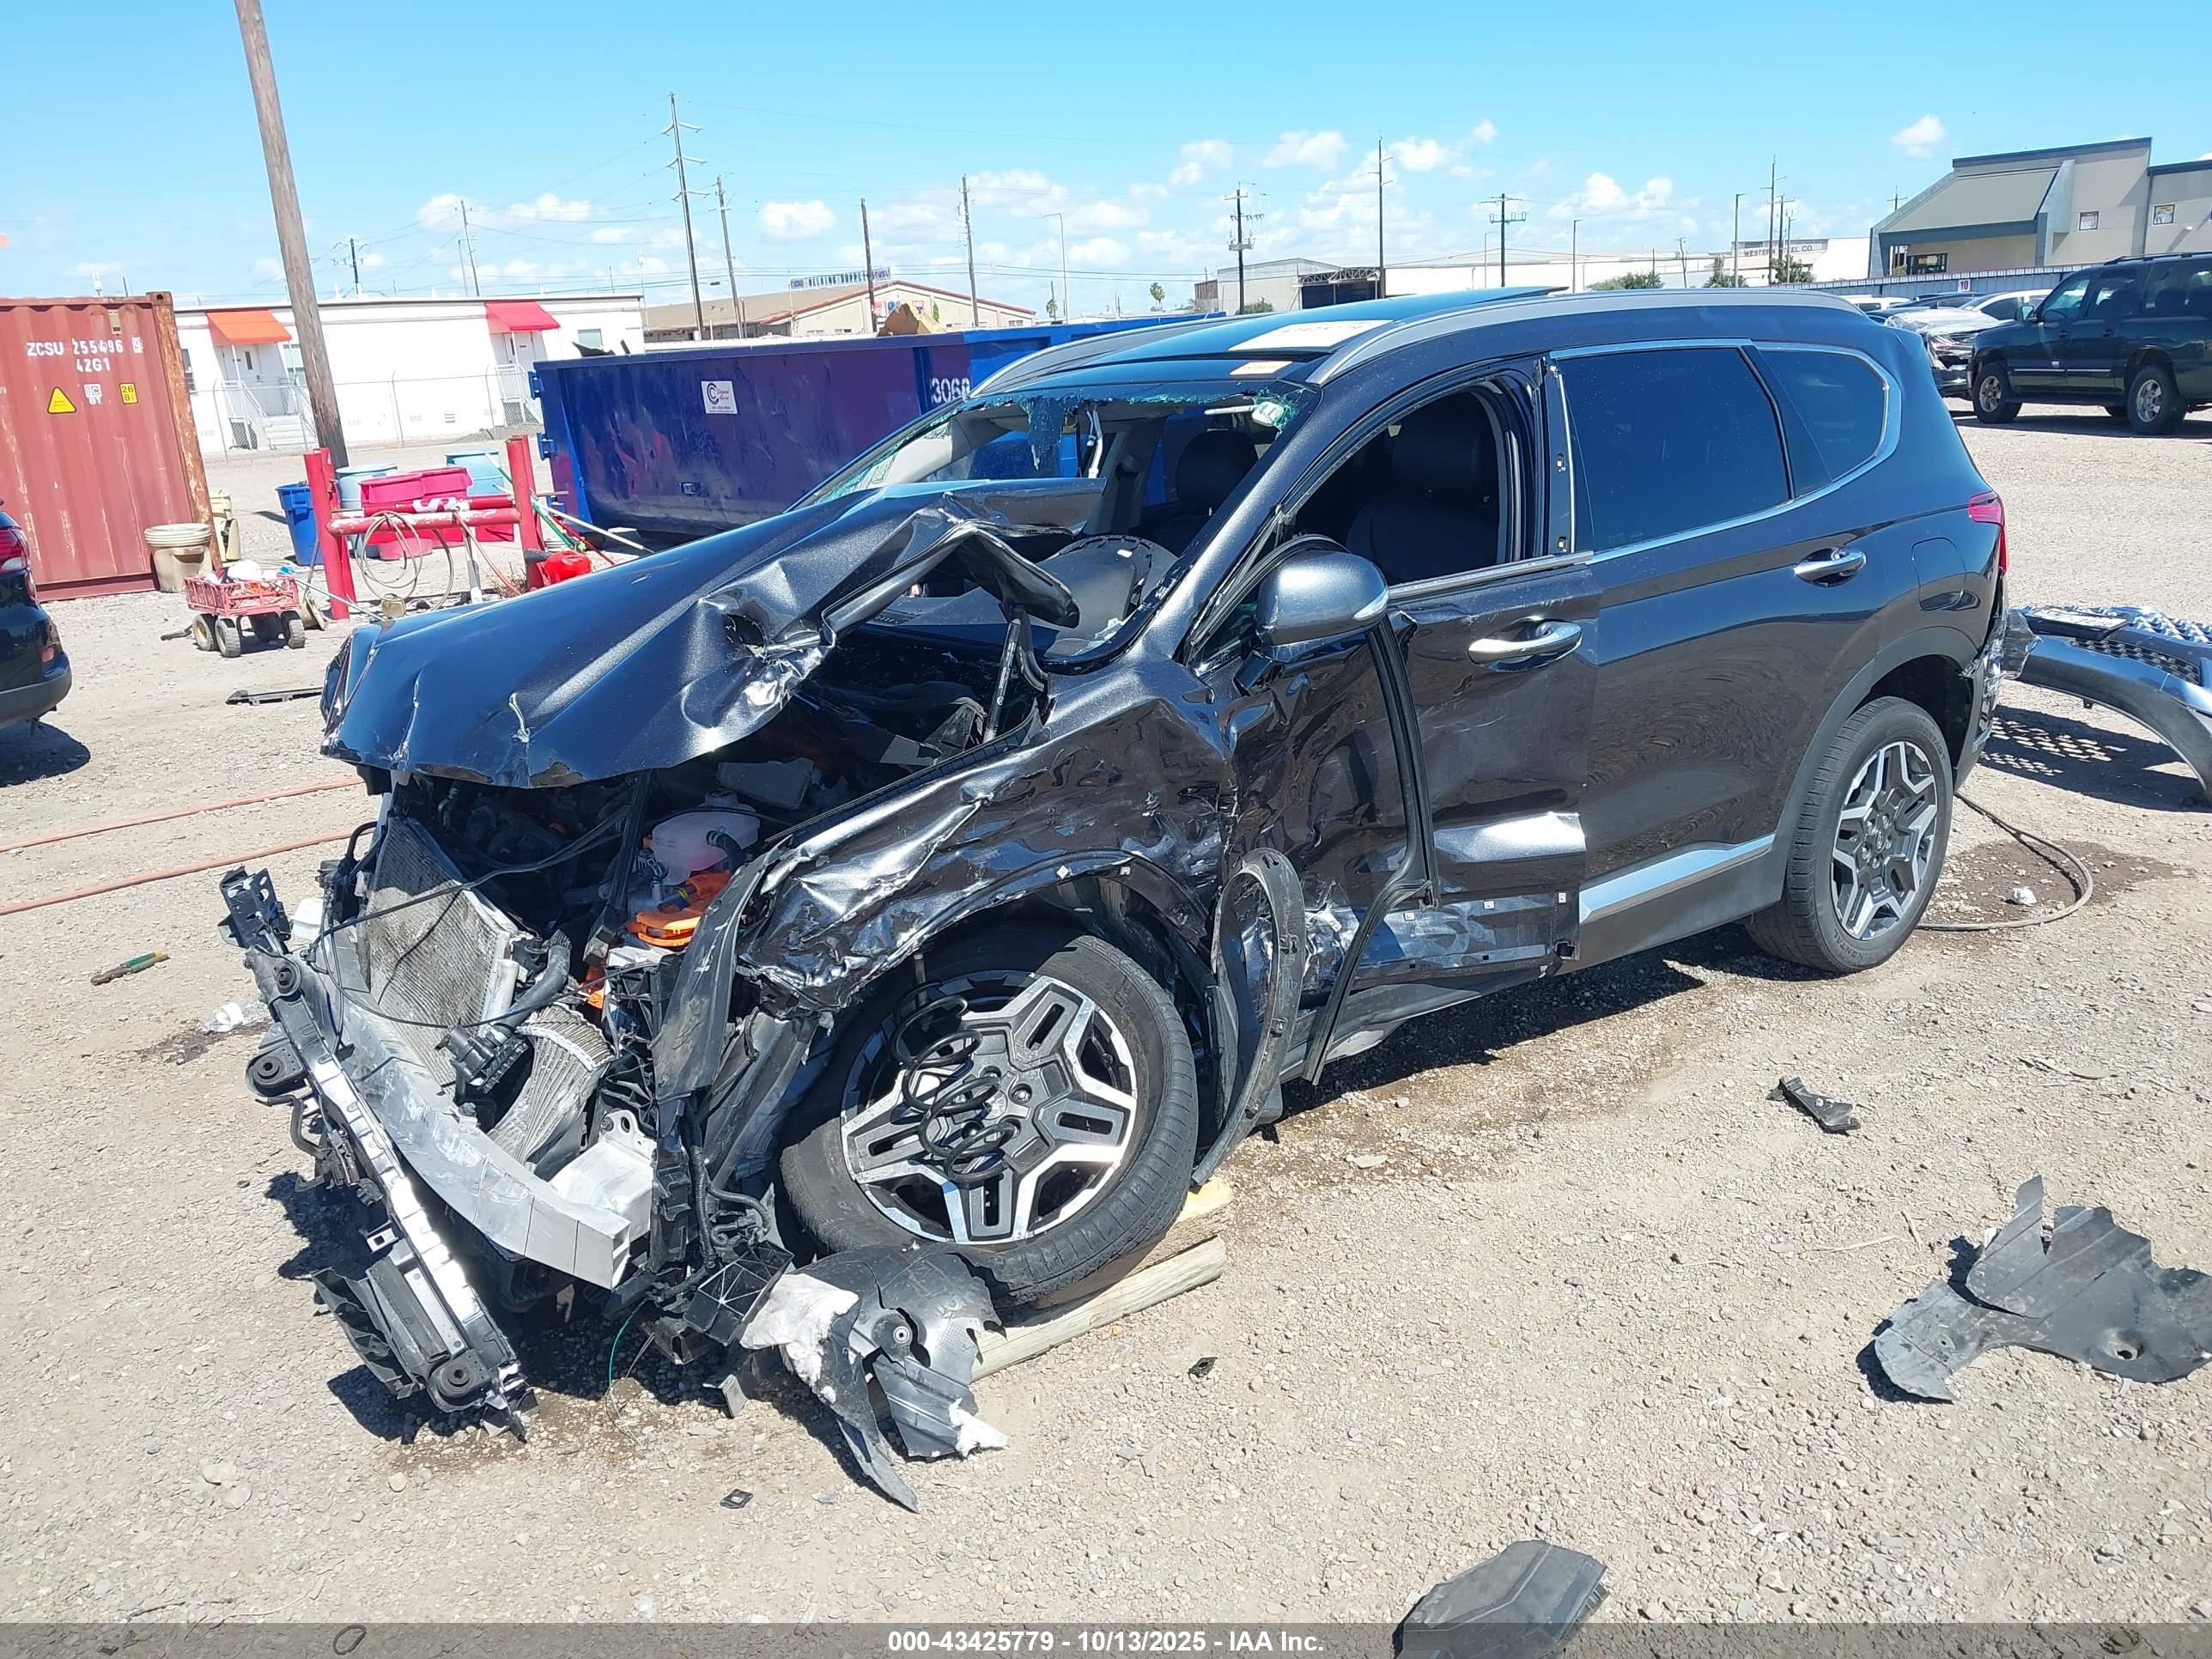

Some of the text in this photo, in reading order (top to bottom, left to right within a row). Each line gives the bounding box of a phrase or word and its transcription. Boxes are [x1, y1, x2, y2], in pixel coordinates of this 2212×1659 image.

[1960, 280, 1969, 290] 10
[26, 341, 64, 356] ZCSU
[72, 338, 124, 356] 255496
[76, 357, 111, 373] 42G1
[932, 378, 970, 403] 3068
